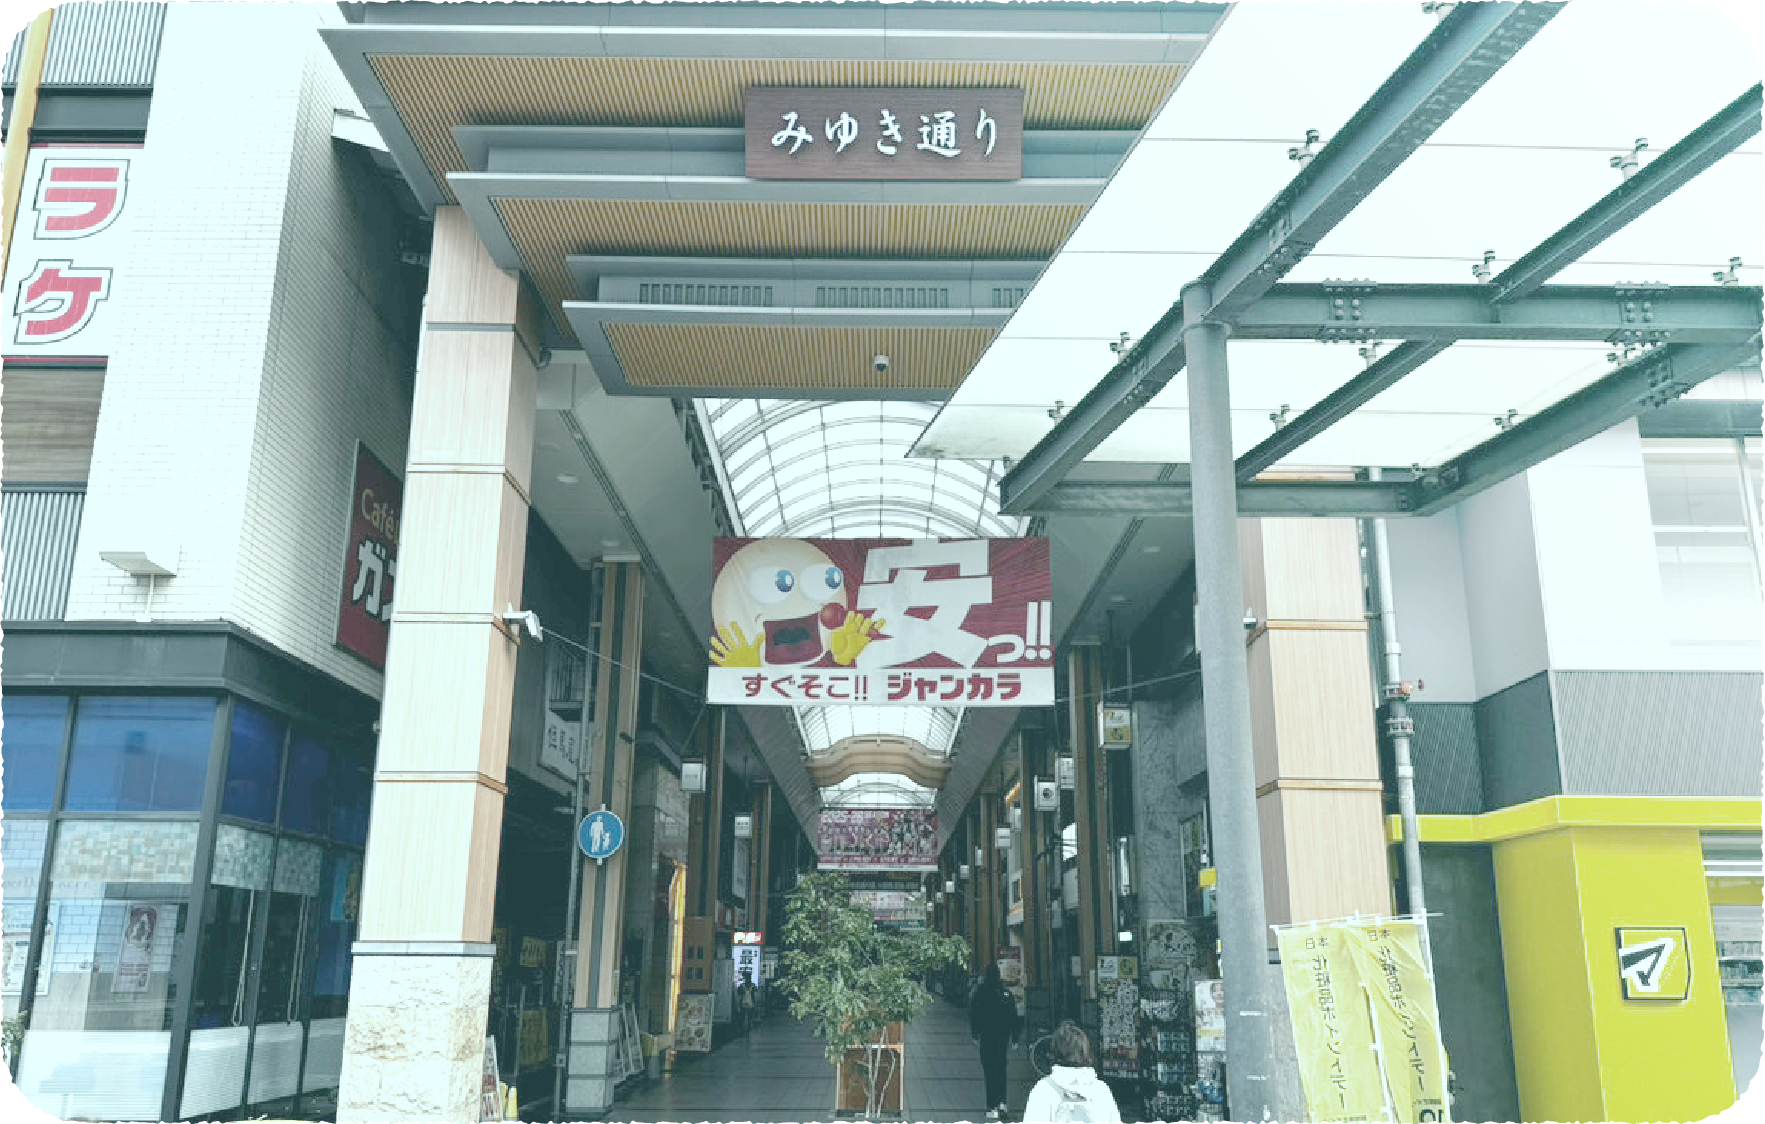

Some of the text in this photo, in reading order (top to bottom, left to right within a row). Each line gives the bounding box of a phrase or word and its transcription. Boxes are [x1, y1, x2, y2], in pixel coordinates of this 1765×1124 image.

[770, 107, 998, 158] みゆき通り
[360, 488, 401, 545] Café
[742, 671, 1022, 702] すぐそこ!! ジャンカラ
